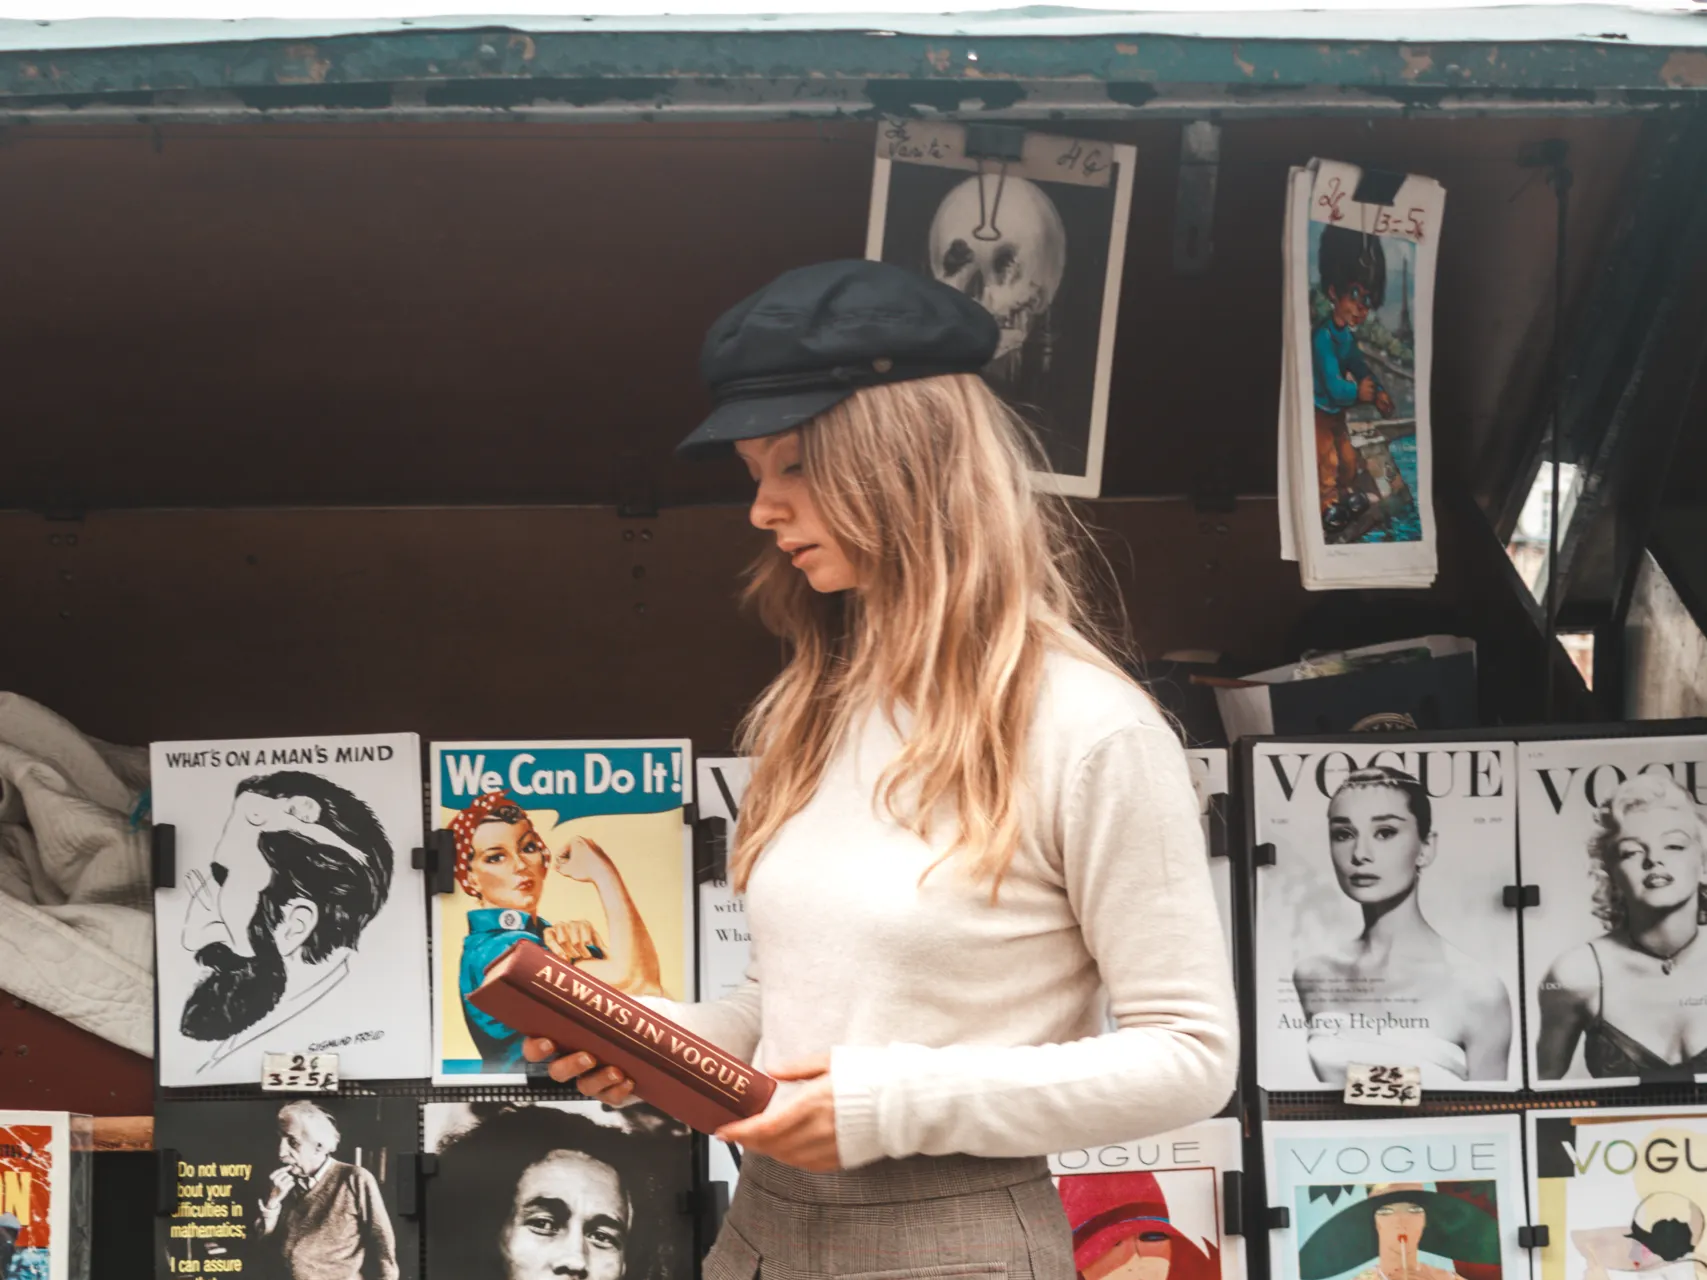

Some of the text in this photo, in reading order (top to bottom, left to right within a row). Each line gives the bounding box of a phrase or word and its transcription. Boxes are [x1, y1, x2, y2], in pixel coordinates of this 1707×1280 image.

[166, 744, 394, 767] WHAT'S ON A MAN'S MIND
[445, 751, 682, 795] We Can Do It!
[535, 965, 751, 1096] ALWAYS IN VOGUE
[1278, 1012, 1430, 1036] Audrey Hepburn
[1059, 1141, 1201, 1169] OGUE
[1291, 1143, 1497, 1175] VOGUE
[198, 1162, 217, 1177] not
[220, 1163, 252, 1181] worry
[177, 1184, 232, 1201] bout your
[231, 1201, 243, 1217] in
[170, 1222, 247, 1239] mathematics;
[170, 1256, 242, 1273] I can assure
